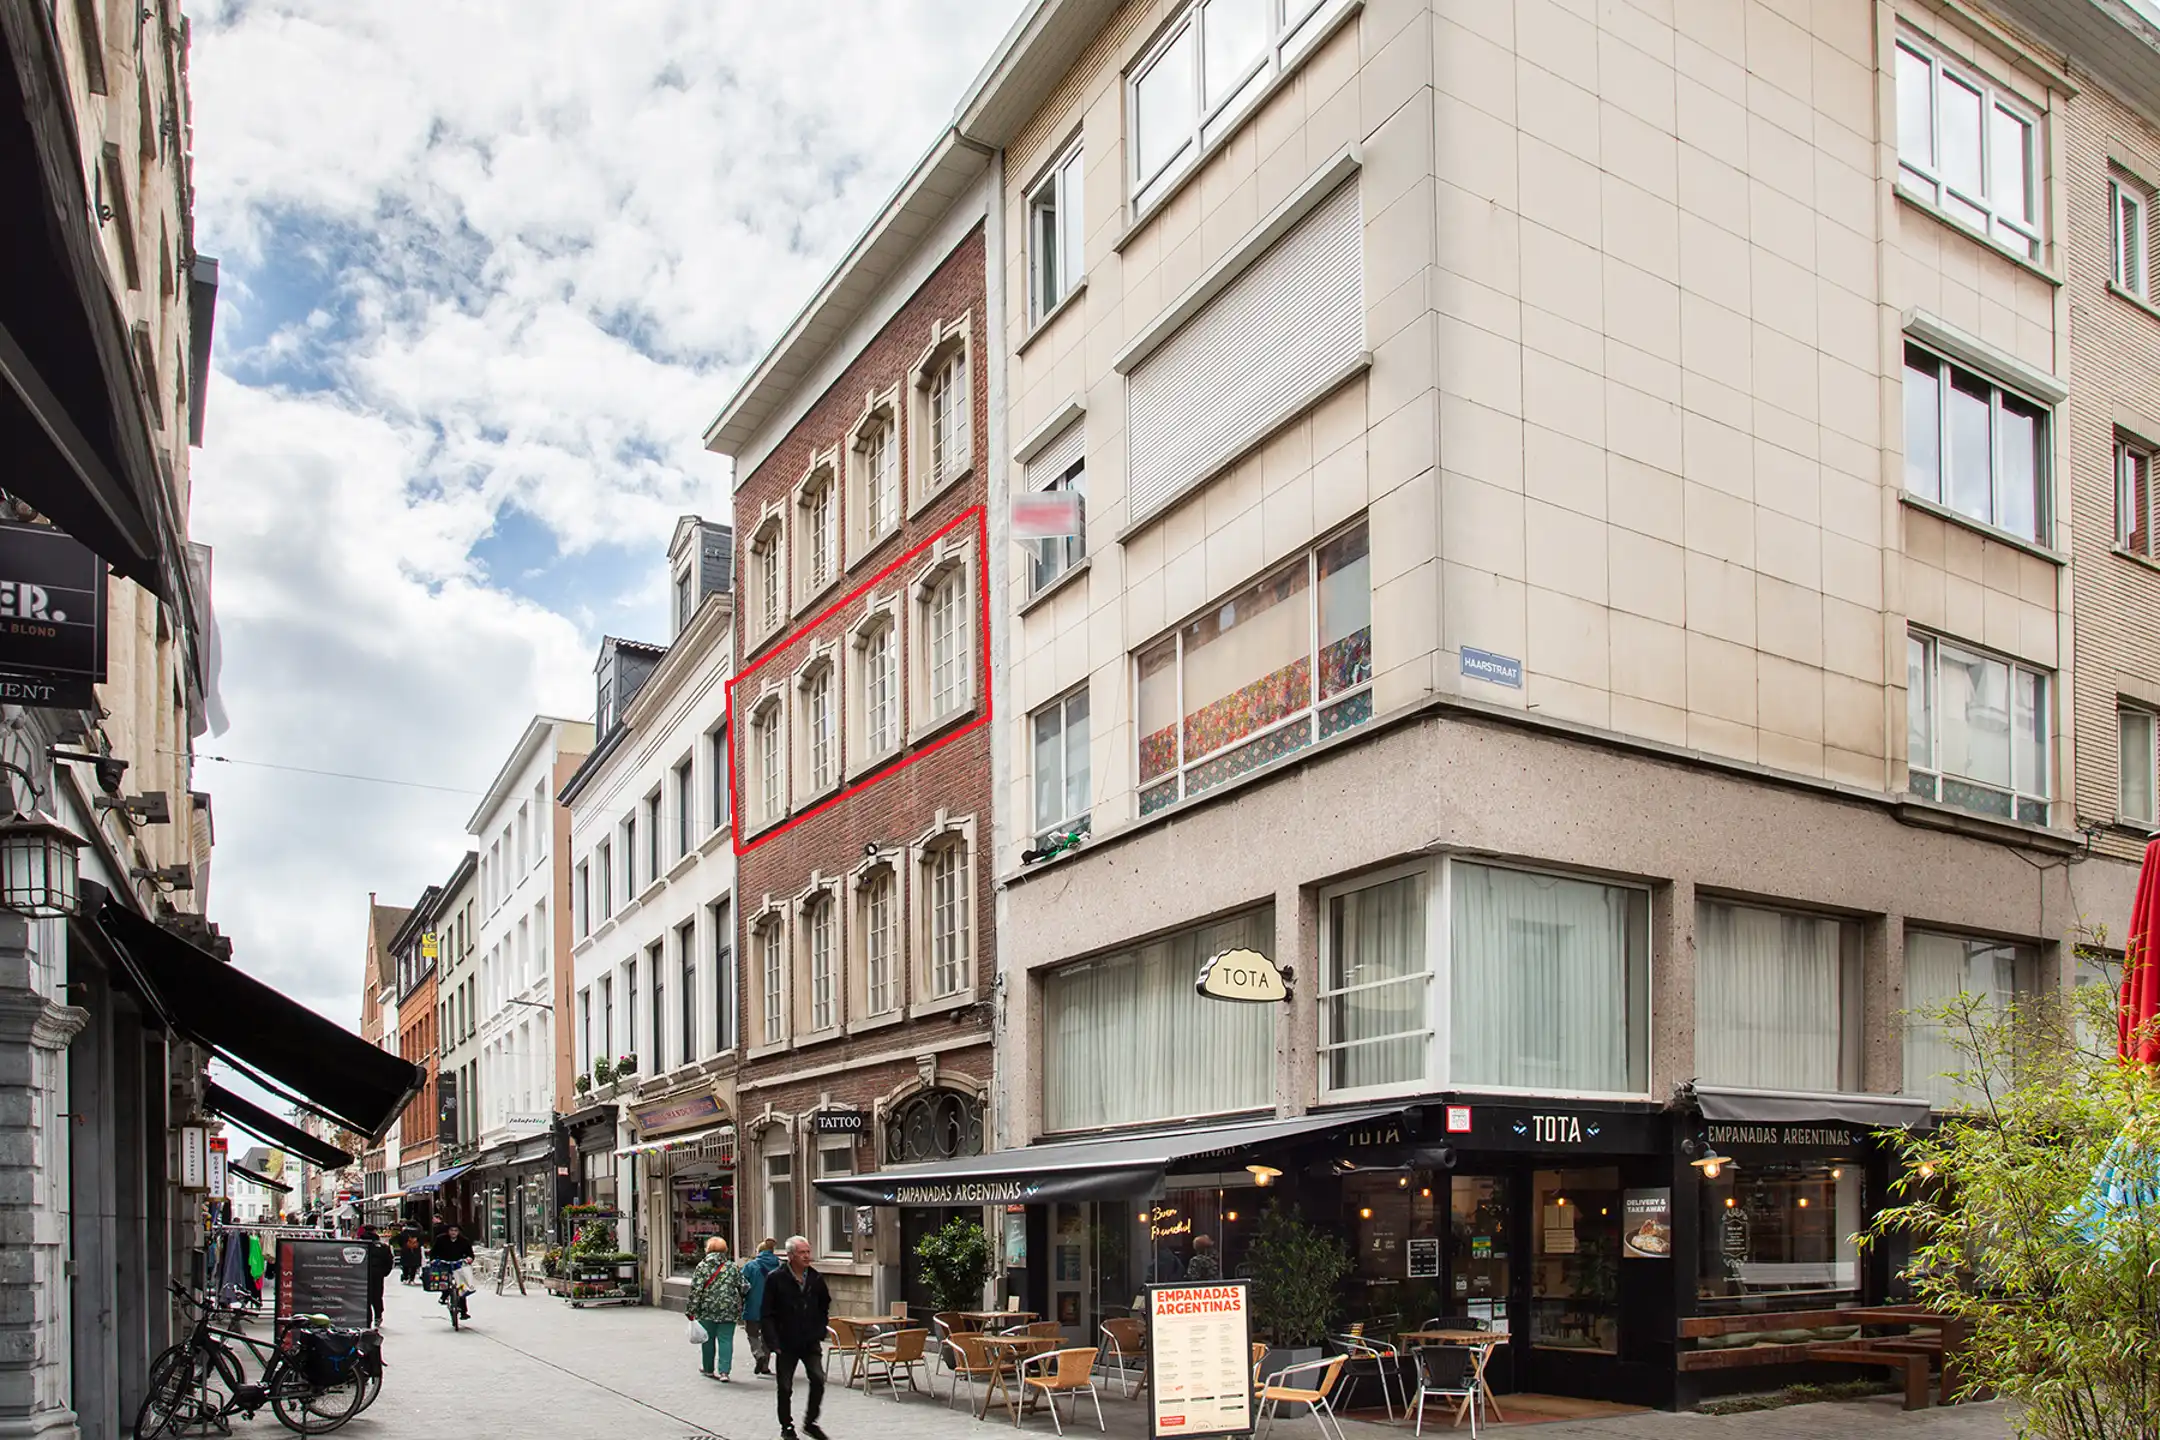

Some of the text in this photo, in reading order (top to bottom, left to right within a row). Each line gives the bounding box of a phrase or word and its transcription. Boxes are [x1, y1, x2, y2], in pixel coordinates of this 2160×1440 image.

[11, 623, 56, 638] BLOND
[1464, 656, 1517, 678] HAARSTRAAT
[1223, 967, 1269, 988] TOTA
[818, 1116, 861, 1128] TATTOO
[1532, 1115, 1582, 1142] TOTA
[1708, 1125, 1850, 1146] EMPANADAS ARGENTINAS
[897, 1181, 1021, 1203] EMPANADAS ARGENTINAS
[1645, 1205, 1666, 1213] AWAY
[1157, 1287, 1240, 1303] EMPANADAS
[1156, 1299, 1241, 1315] ARGENTINAS
